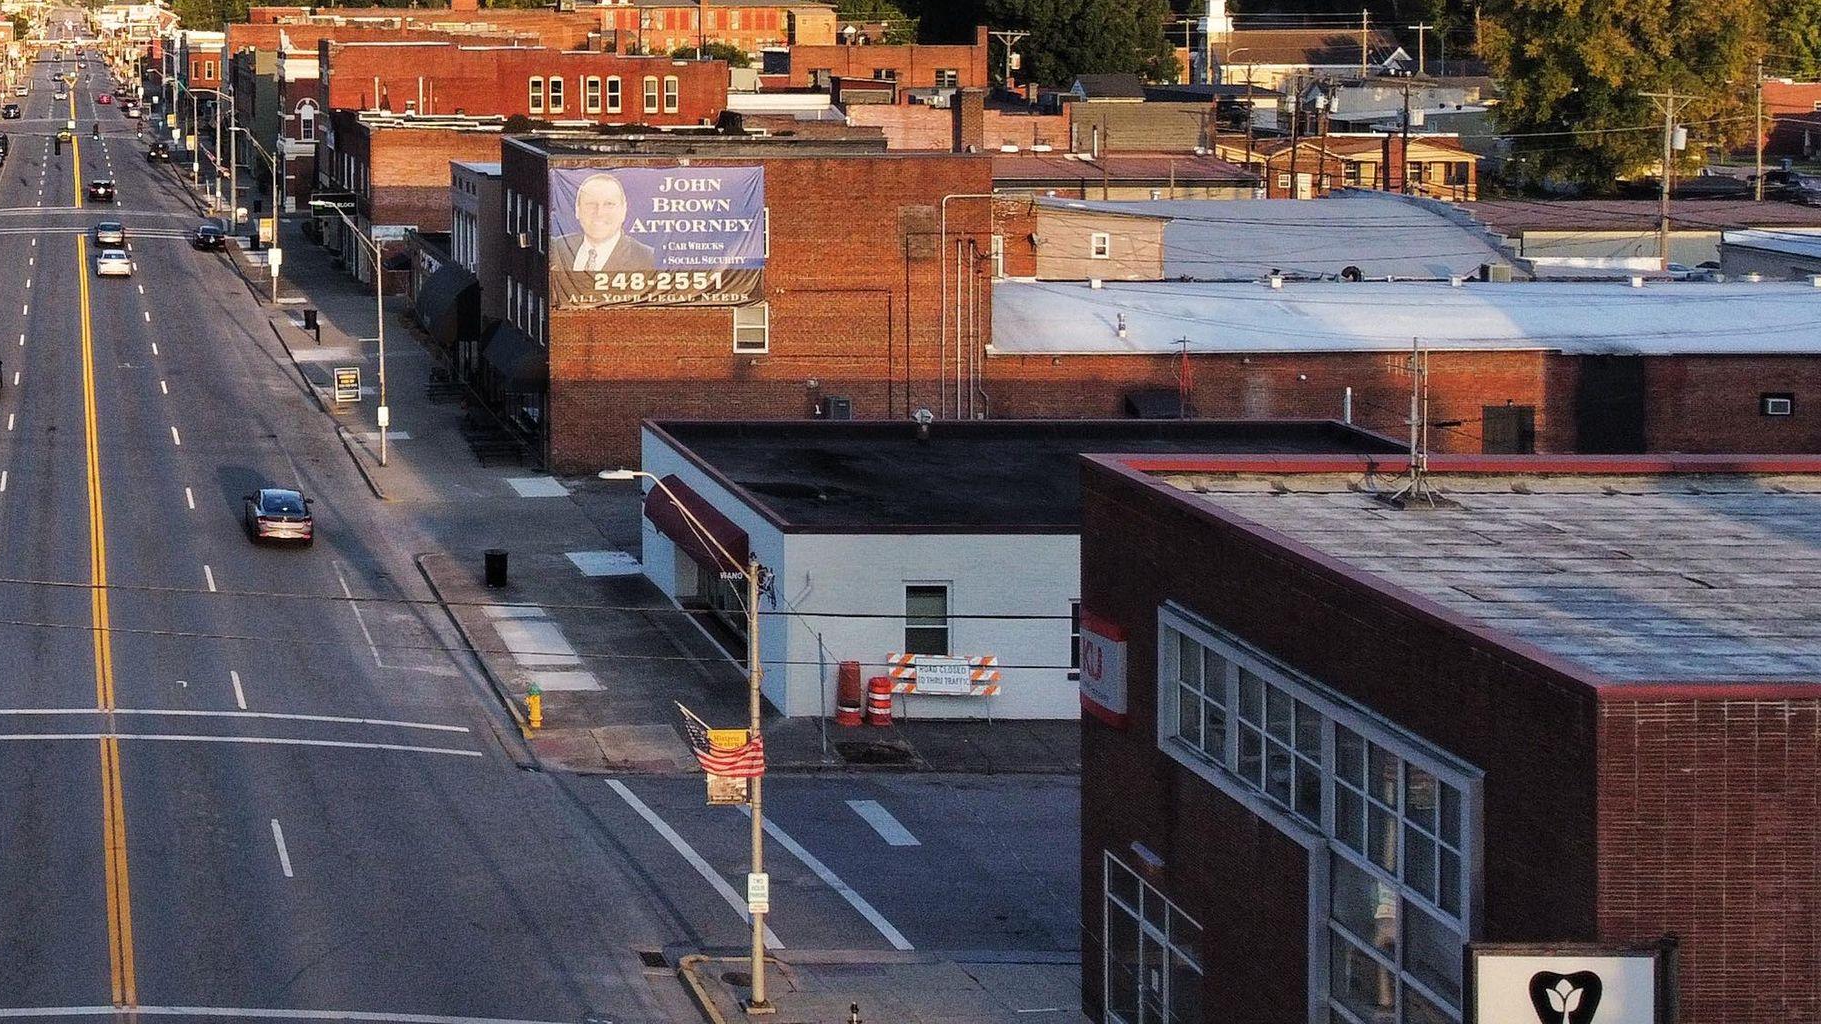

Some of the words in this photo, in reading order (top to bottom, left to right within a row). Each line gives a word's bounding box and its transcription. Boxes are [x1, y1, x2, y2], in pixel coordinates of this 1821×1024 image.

[659, 177, 722, 192] JOHN
[652, 197, 731, 213] BROWN
[629, 217, 754, 233] ATTORNEY
[668, 242, 687, 250] CAR
[688, 241, 724, 250] WRECKS
[668, 256, 701, 264] SOCIAL
[702, 256, 746, 264] SECURITY
[594, 272, 723, 291] 248-2551
[569, 294, 597, 302] ALL
[603, 293, 642, 302] YOUR
[648, 293, 696, 302] LEGAL
[701, 293, 749, 302] NEEDS
